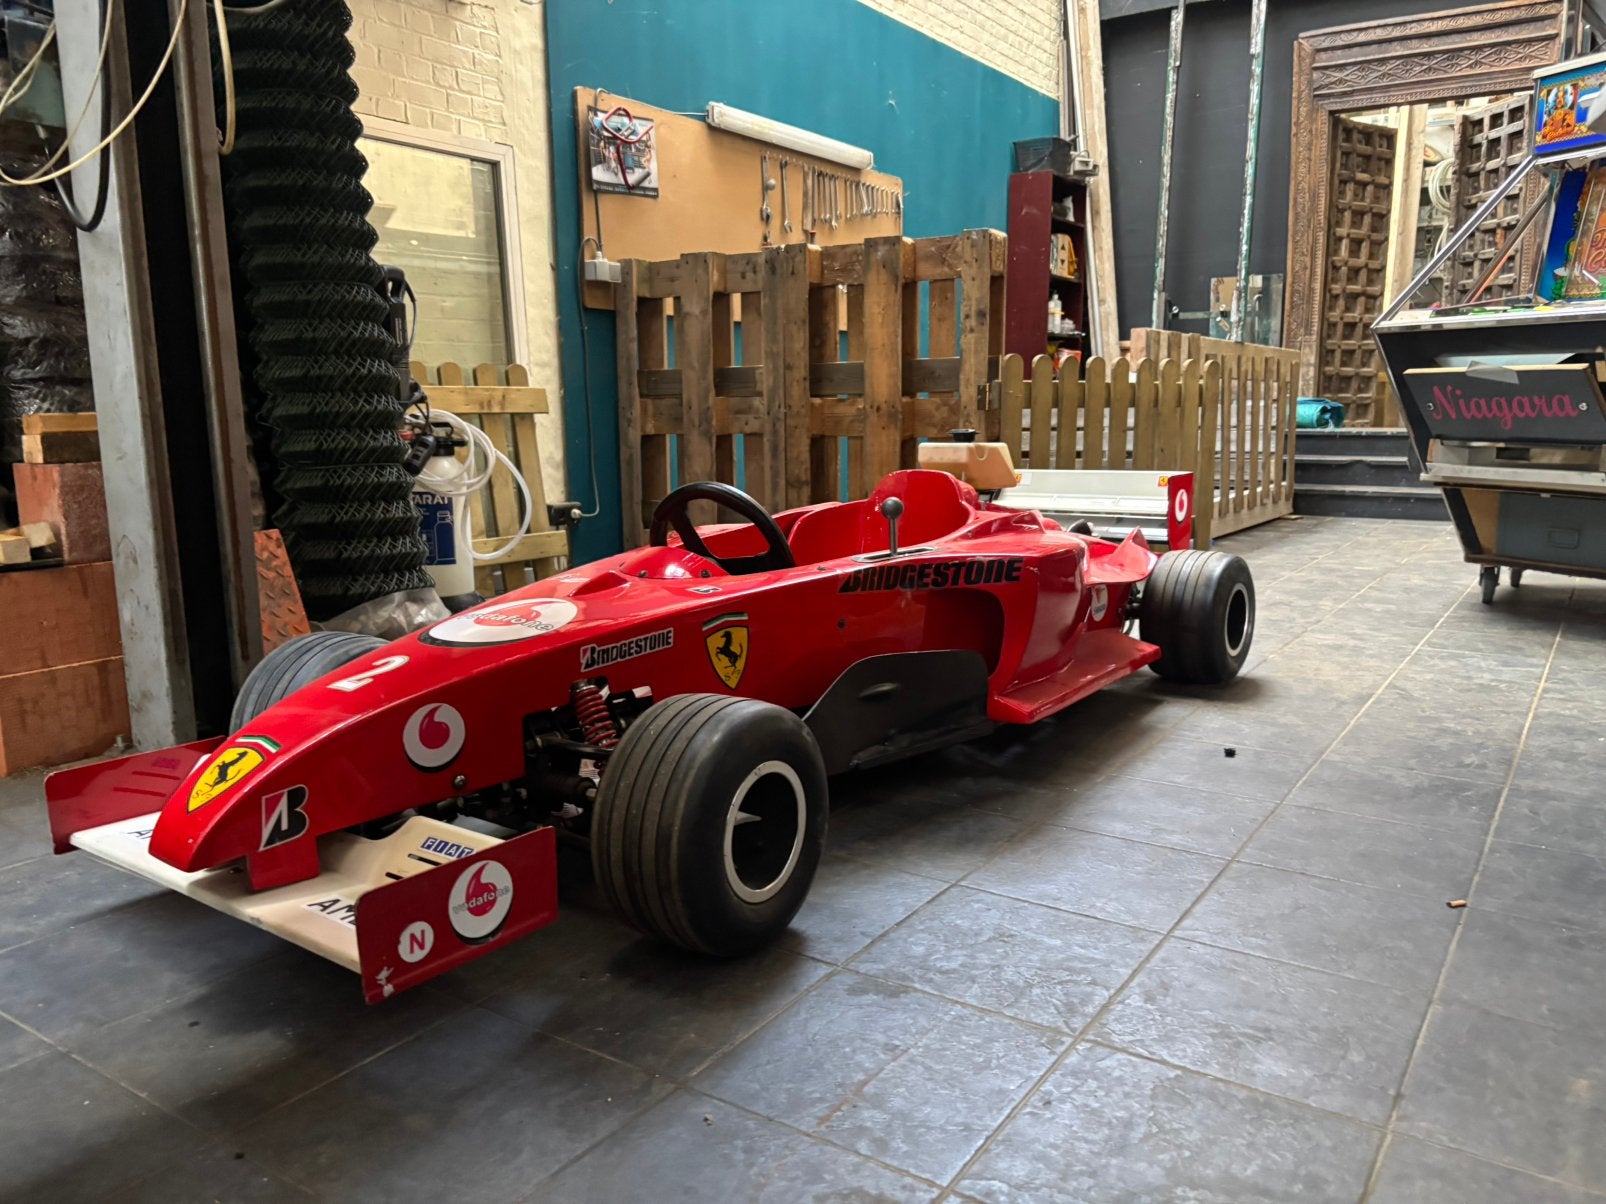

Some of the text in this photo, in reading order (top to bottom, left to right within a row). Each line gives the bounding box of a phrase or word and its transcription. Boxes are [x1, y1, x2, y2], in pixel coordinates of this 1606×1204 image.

[1431, 385, 1580, 430] Niagara
[838, 557, 1025, 594] BRIDGESTONE
[581, 629, 673, 670] BRIDGESTONE
[325, 655, 410, 692] 2
[421, 837, 474, 858] FIAT
[408, 929, 426, 954] N
